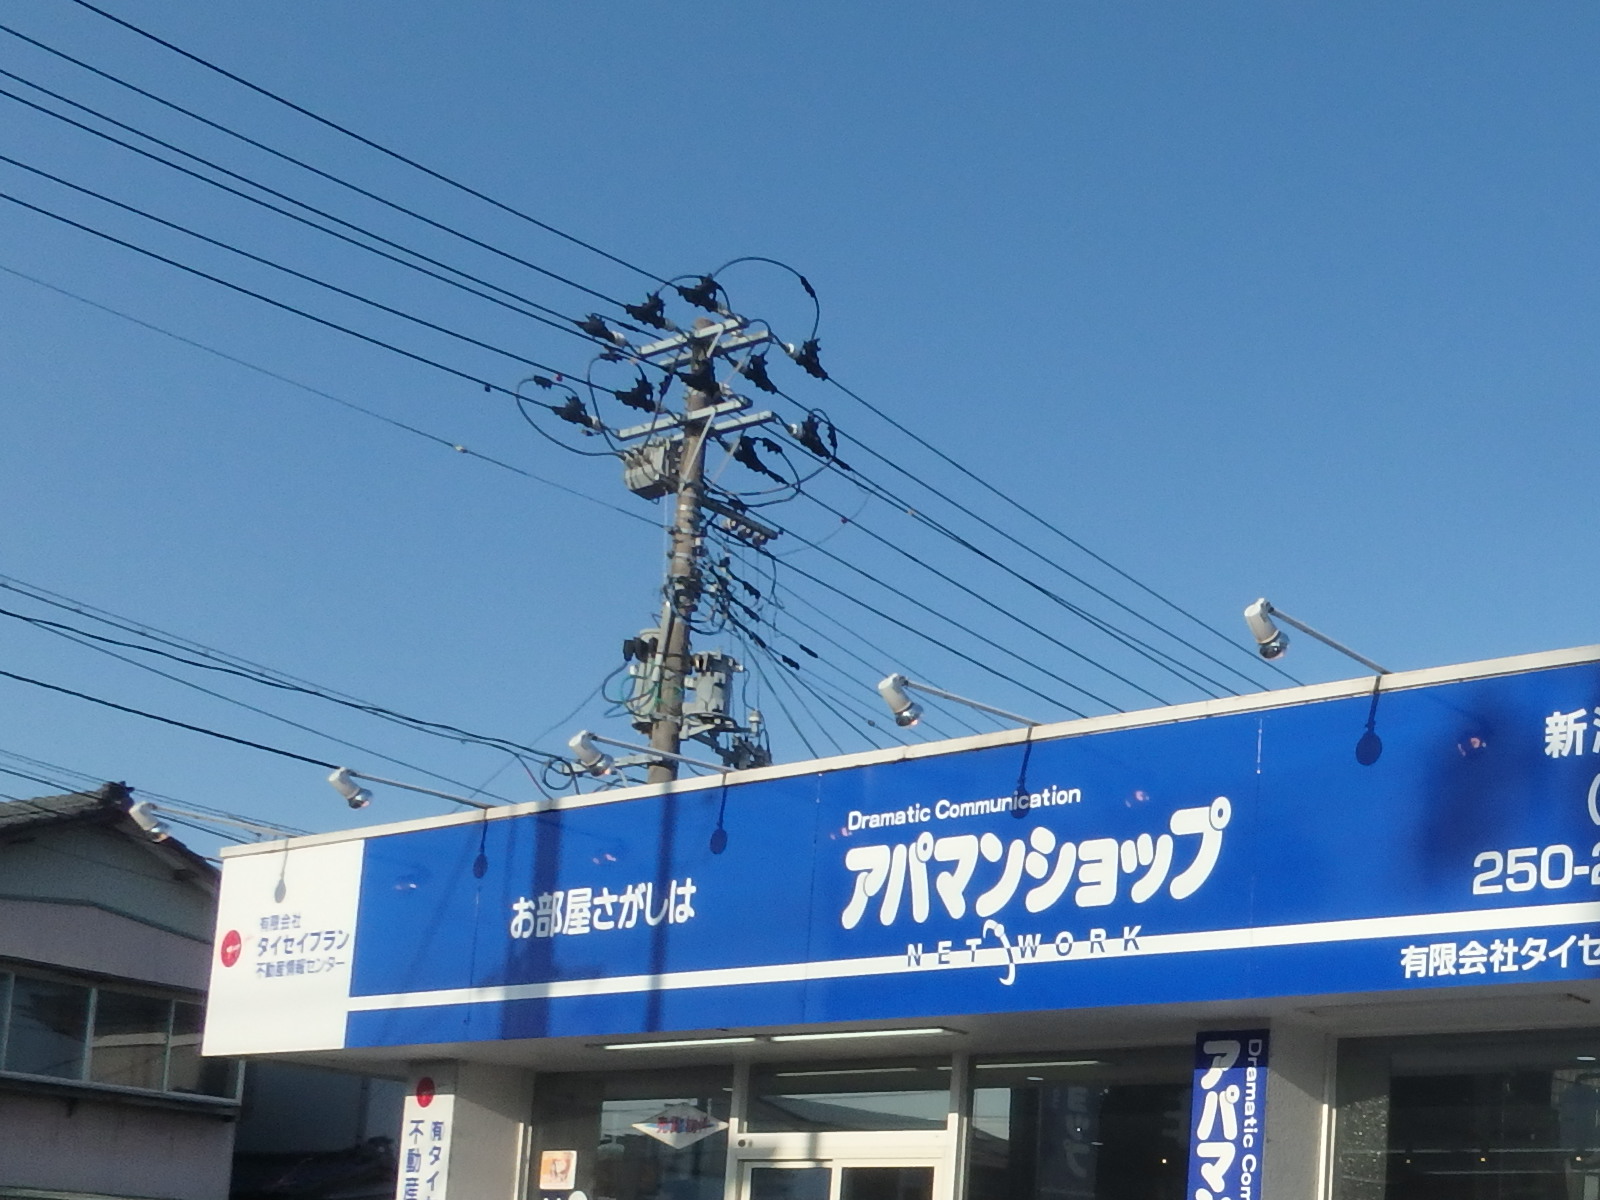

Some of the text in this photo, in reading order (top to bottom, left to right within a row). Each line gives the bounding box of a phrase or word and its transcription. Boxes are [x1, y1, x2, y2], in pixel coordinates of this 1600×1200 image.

[847, 785, 1081, 831] Dramatic Communication
[841, 796, 1232, 930] アパマンショップ
[509, 877, 698, 940] お部屋さがしは
[1242, 1038, 1263, 1147] Dramatic
